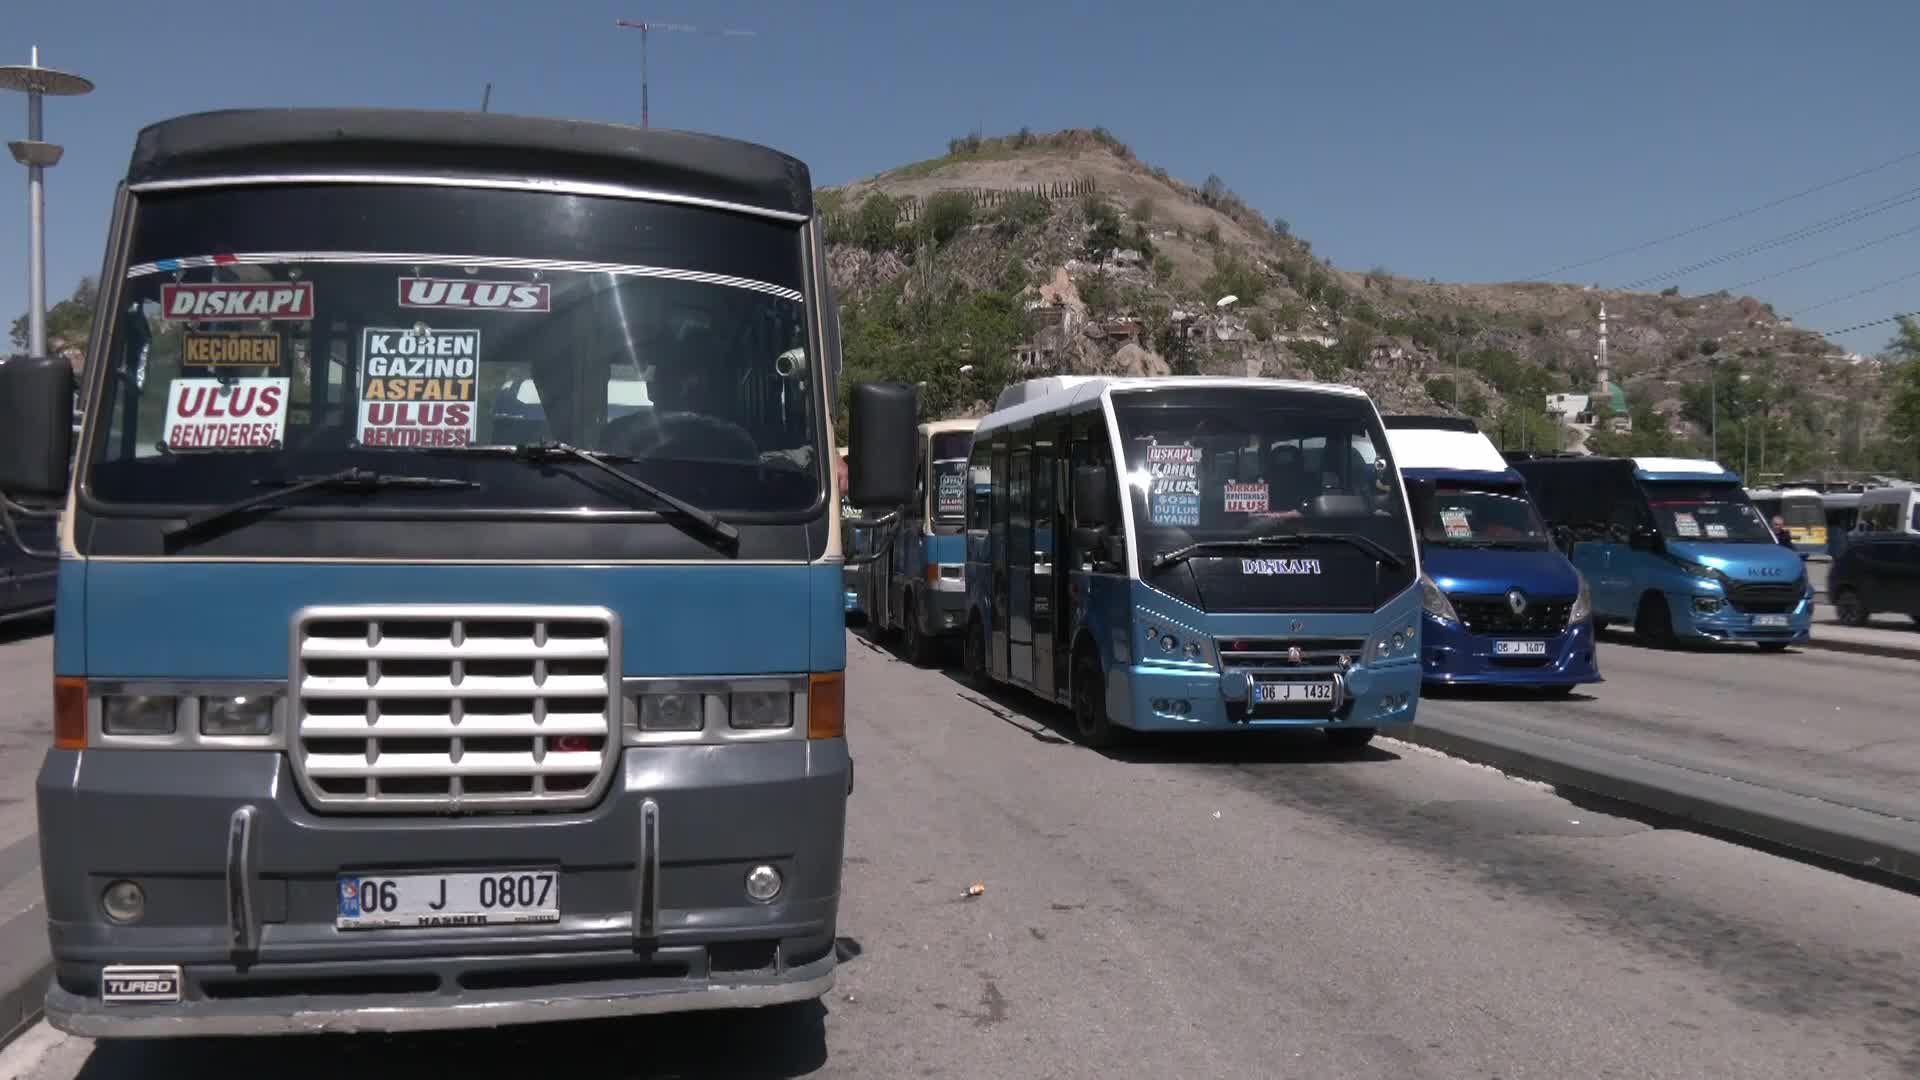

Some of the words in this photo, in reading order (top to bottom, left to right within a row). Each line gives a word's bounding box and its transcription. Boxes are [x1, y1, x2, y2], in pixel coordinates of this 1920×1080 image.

[407, 281, 541, 308] ULUS
[366, 378, 474, 401] ASFALT
[177, 386, 281, 418] ULUS
[367, 403, 471, 426] ULUS
[1227, 500, 1266, 511] ULUS
[1262, 685, 1276, 700] 06
[1283, 684, 1290, 699] J
[1304, 684, 1330, 698] 1432
[360, 880, 398, 912] 06
[428, 879, 447, 909] J
[479, 875, 554, 908] 0807
[109, 980, 172, 993] TURBO
